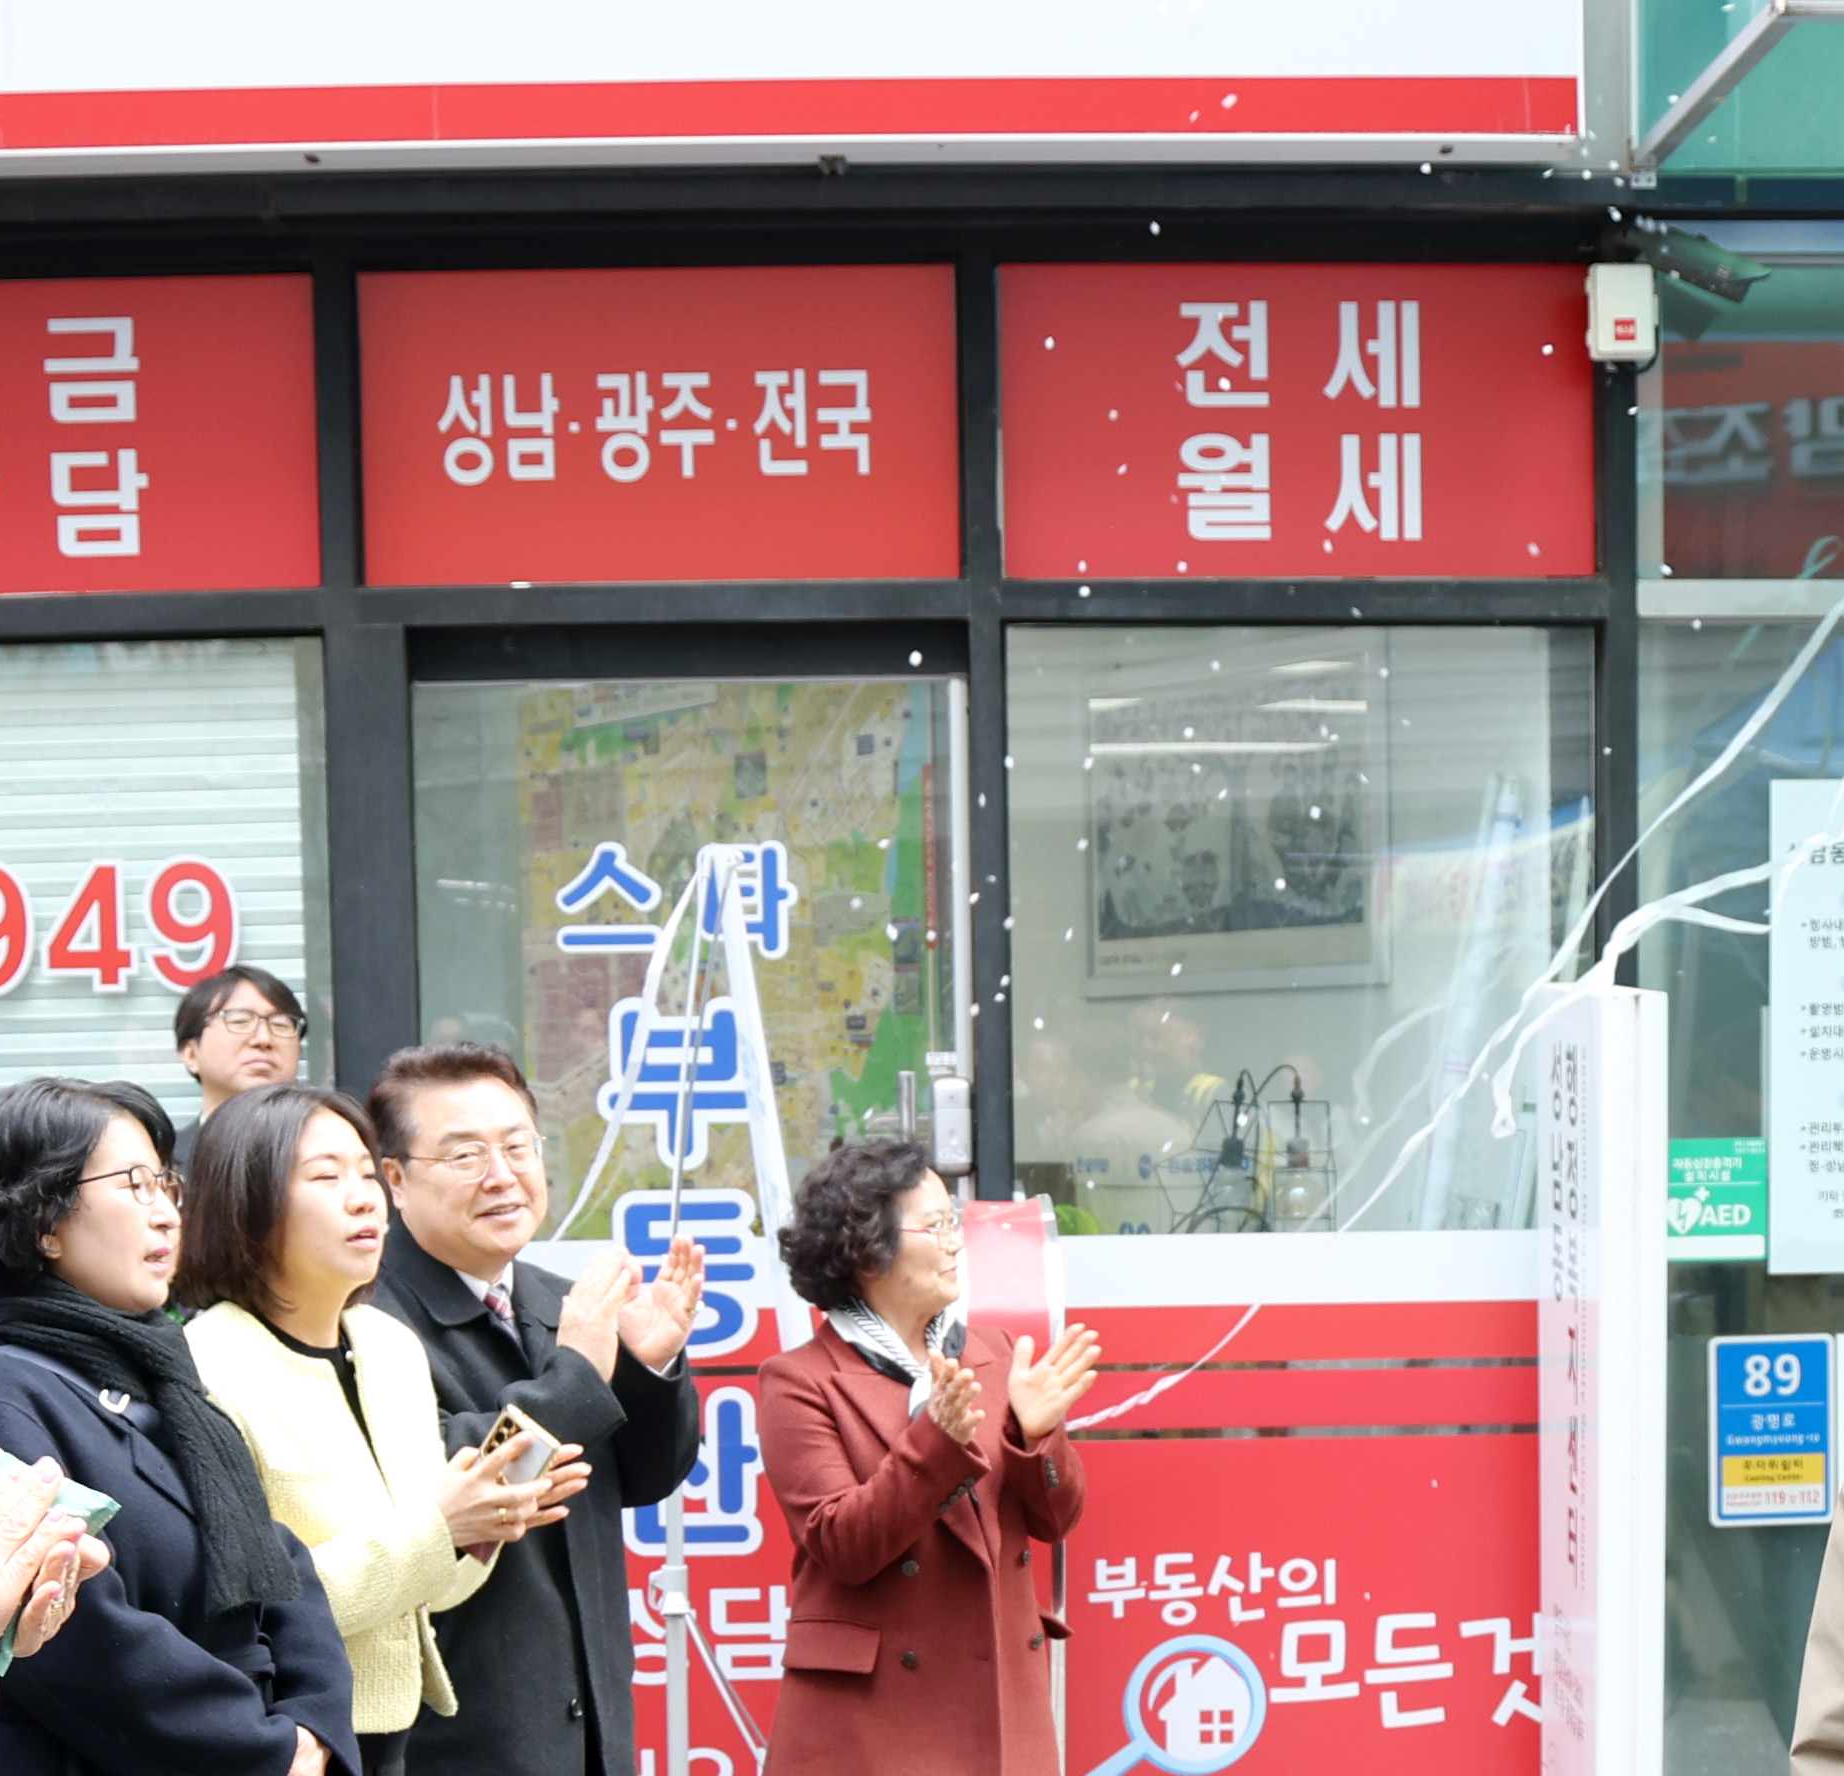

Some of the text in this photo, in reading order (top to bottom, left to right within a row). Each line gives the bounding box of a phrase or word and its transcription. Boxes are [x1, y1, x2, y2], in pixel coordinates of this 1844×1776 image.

[1175, 300, 1421, 408] 전세
[1176, 432, 1422, 541] 월세
[1699, 1204, 1753, 1227] AED
[1744, 1353, 1802, 1396] 89
[1751, 1413, 1796, 1431] 광명로
[1764, 1490, 1787, 1505] 119
[1088, 1552, 1336, 1626] 부동산의
